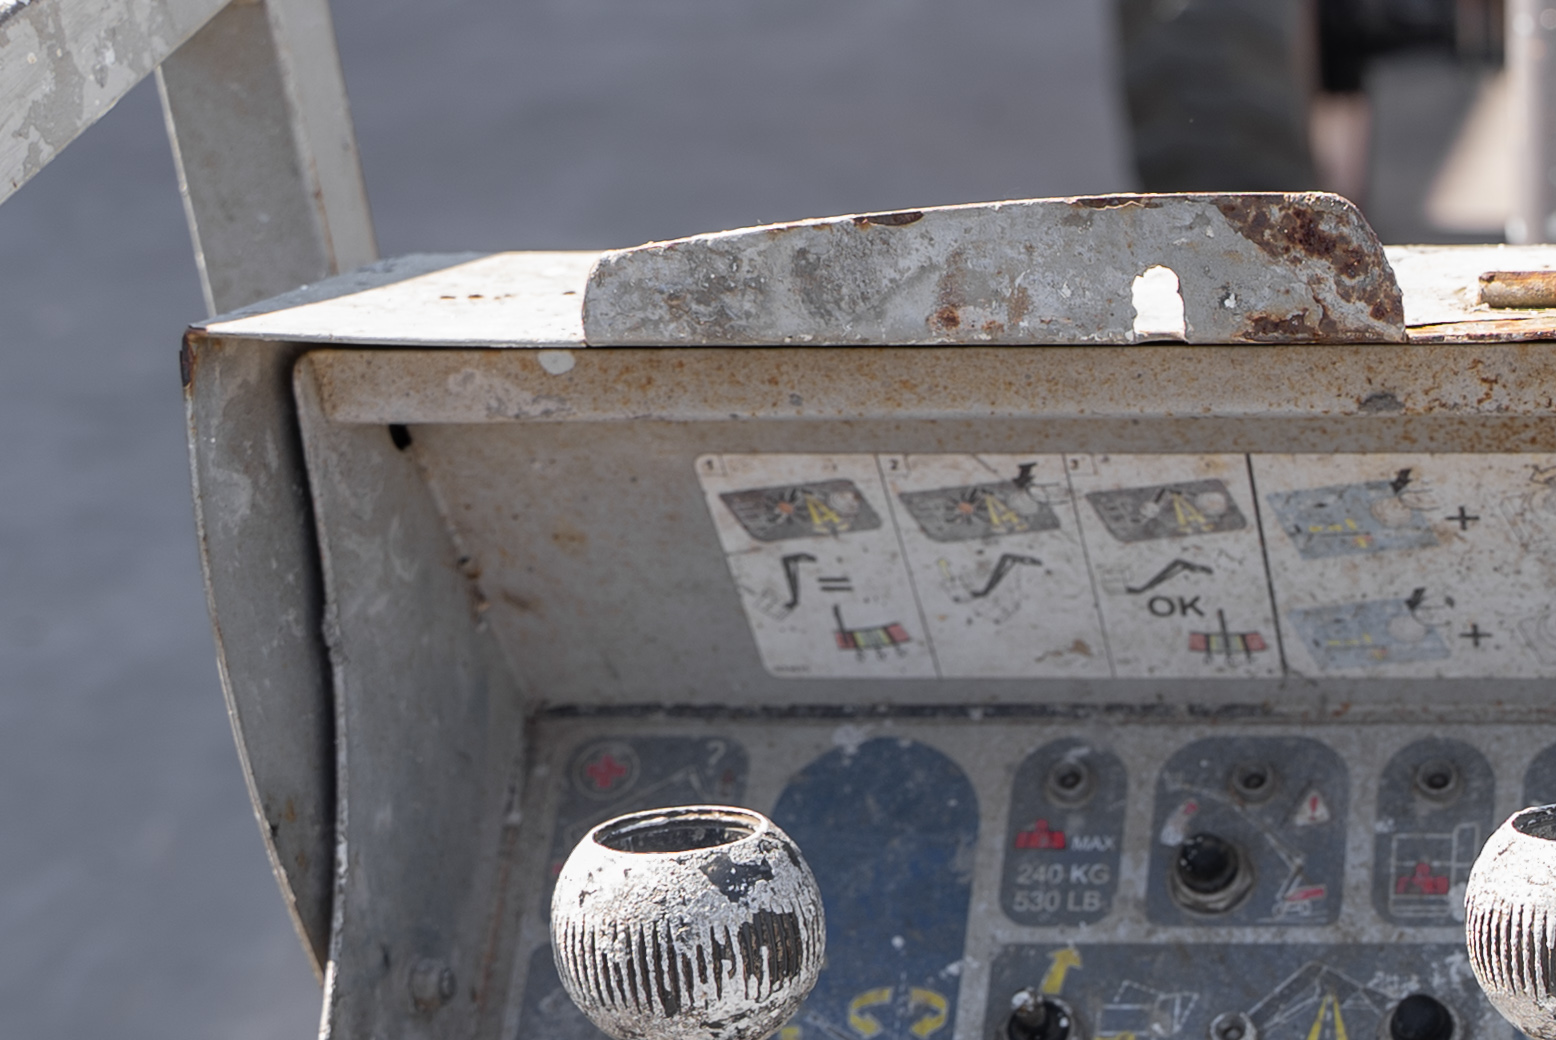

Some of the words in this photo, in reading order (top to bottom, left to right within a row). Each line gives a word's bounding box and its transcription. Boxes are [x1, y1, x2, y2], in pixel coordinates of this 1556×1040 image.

[1147, 595, 1205, 617] OK
[1071, 835, 1116, 852] MAX
[1017, 863, 1064, 885] 240
[1070, 863, 1110, 885] KG
[1013, 890, 1061, 912] 530
[1067, 890, 1102, 912] LB
